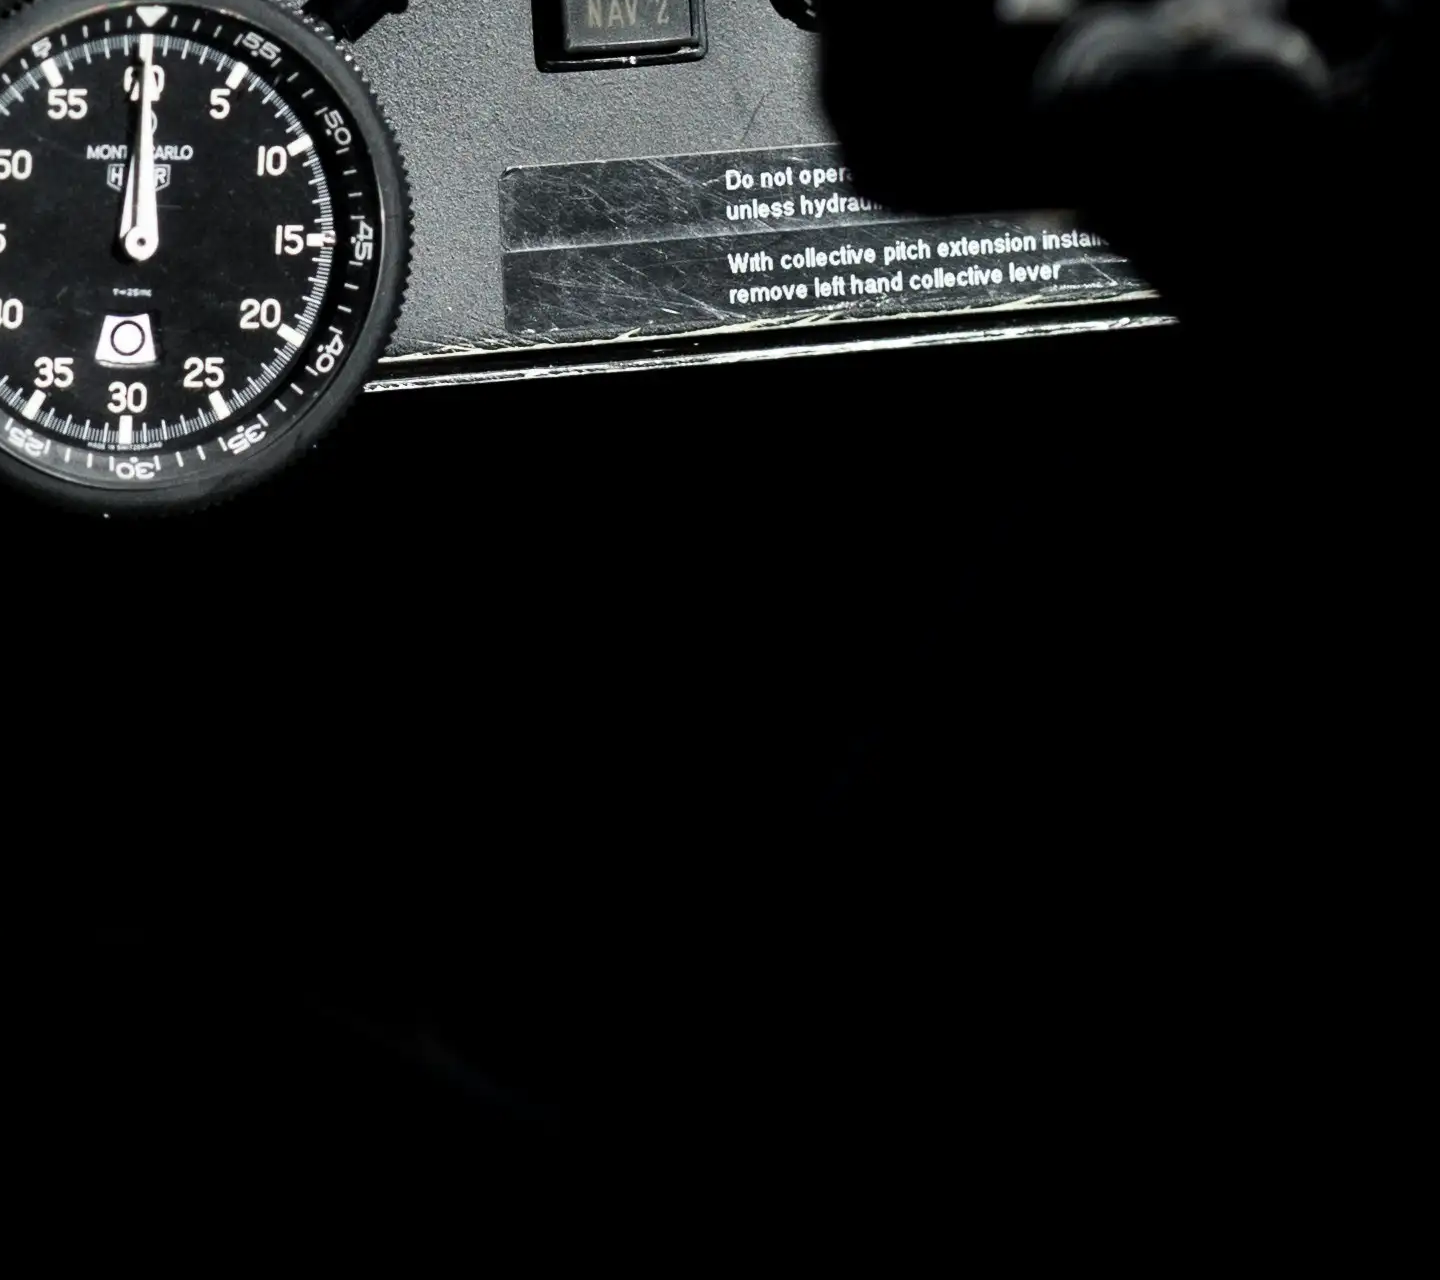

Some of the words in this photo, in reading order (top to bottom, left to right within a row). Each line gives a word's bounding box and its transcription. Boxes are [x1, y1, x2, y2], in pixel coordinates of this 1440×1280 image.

[47, 88, 88, 121] 55
[209, 88, 230, 121] 5
[257, 146, 288, 177] 10
[725, 169, 754, 191] Do
[760, 166, 793, 189] not
[726, 196, 795, 221] unless
[275, 224, 304, 255] 15
[727, 251, 774, 274] With
[780, 242, 876, 271] collective
[884, 238, 931, 266] pitch
[937, 231, 1037, 258] extension
[729, 280, 808, 305] remove
[814, 275, 845, 299] left
[850, 270, 903, 295] hand
[909, 262, 1003, 290] collective
[1009, 260, 1061, 284] lever
[240, 299, 281, 330] 20
[34, 357, 74, 389] 35
[183, 357, 225, 389] 25
[108, 381, 148, 414] 30
